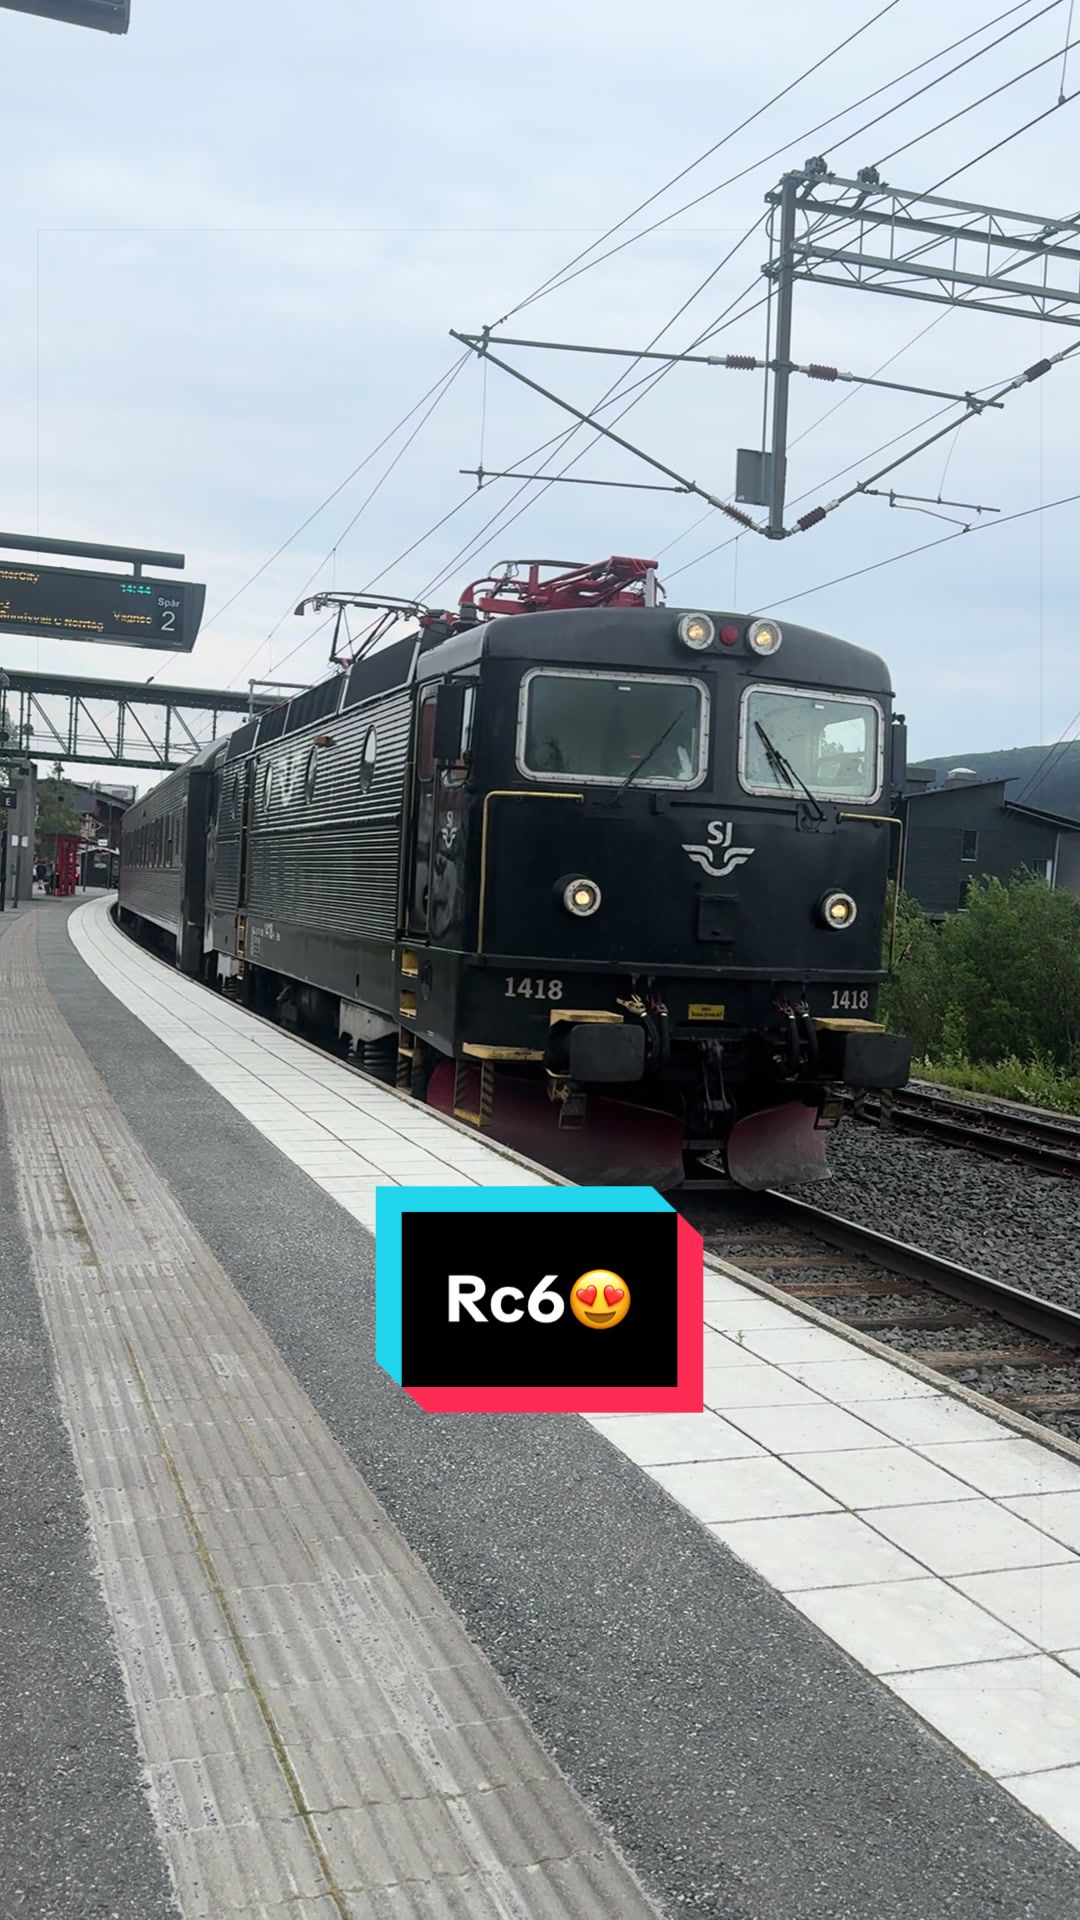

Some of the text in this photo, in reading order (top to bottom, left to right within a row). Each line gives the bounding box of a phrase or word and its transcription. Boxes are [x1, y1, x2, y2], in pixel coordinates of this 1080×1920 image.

[157, 597, 181, 609] Spår
[161, 610, 176, 632] 2
[707, 820, 733, 847] SJ
[505, 977, 563, 1000] 1418
[831, 990, 869, 1010] 1418
